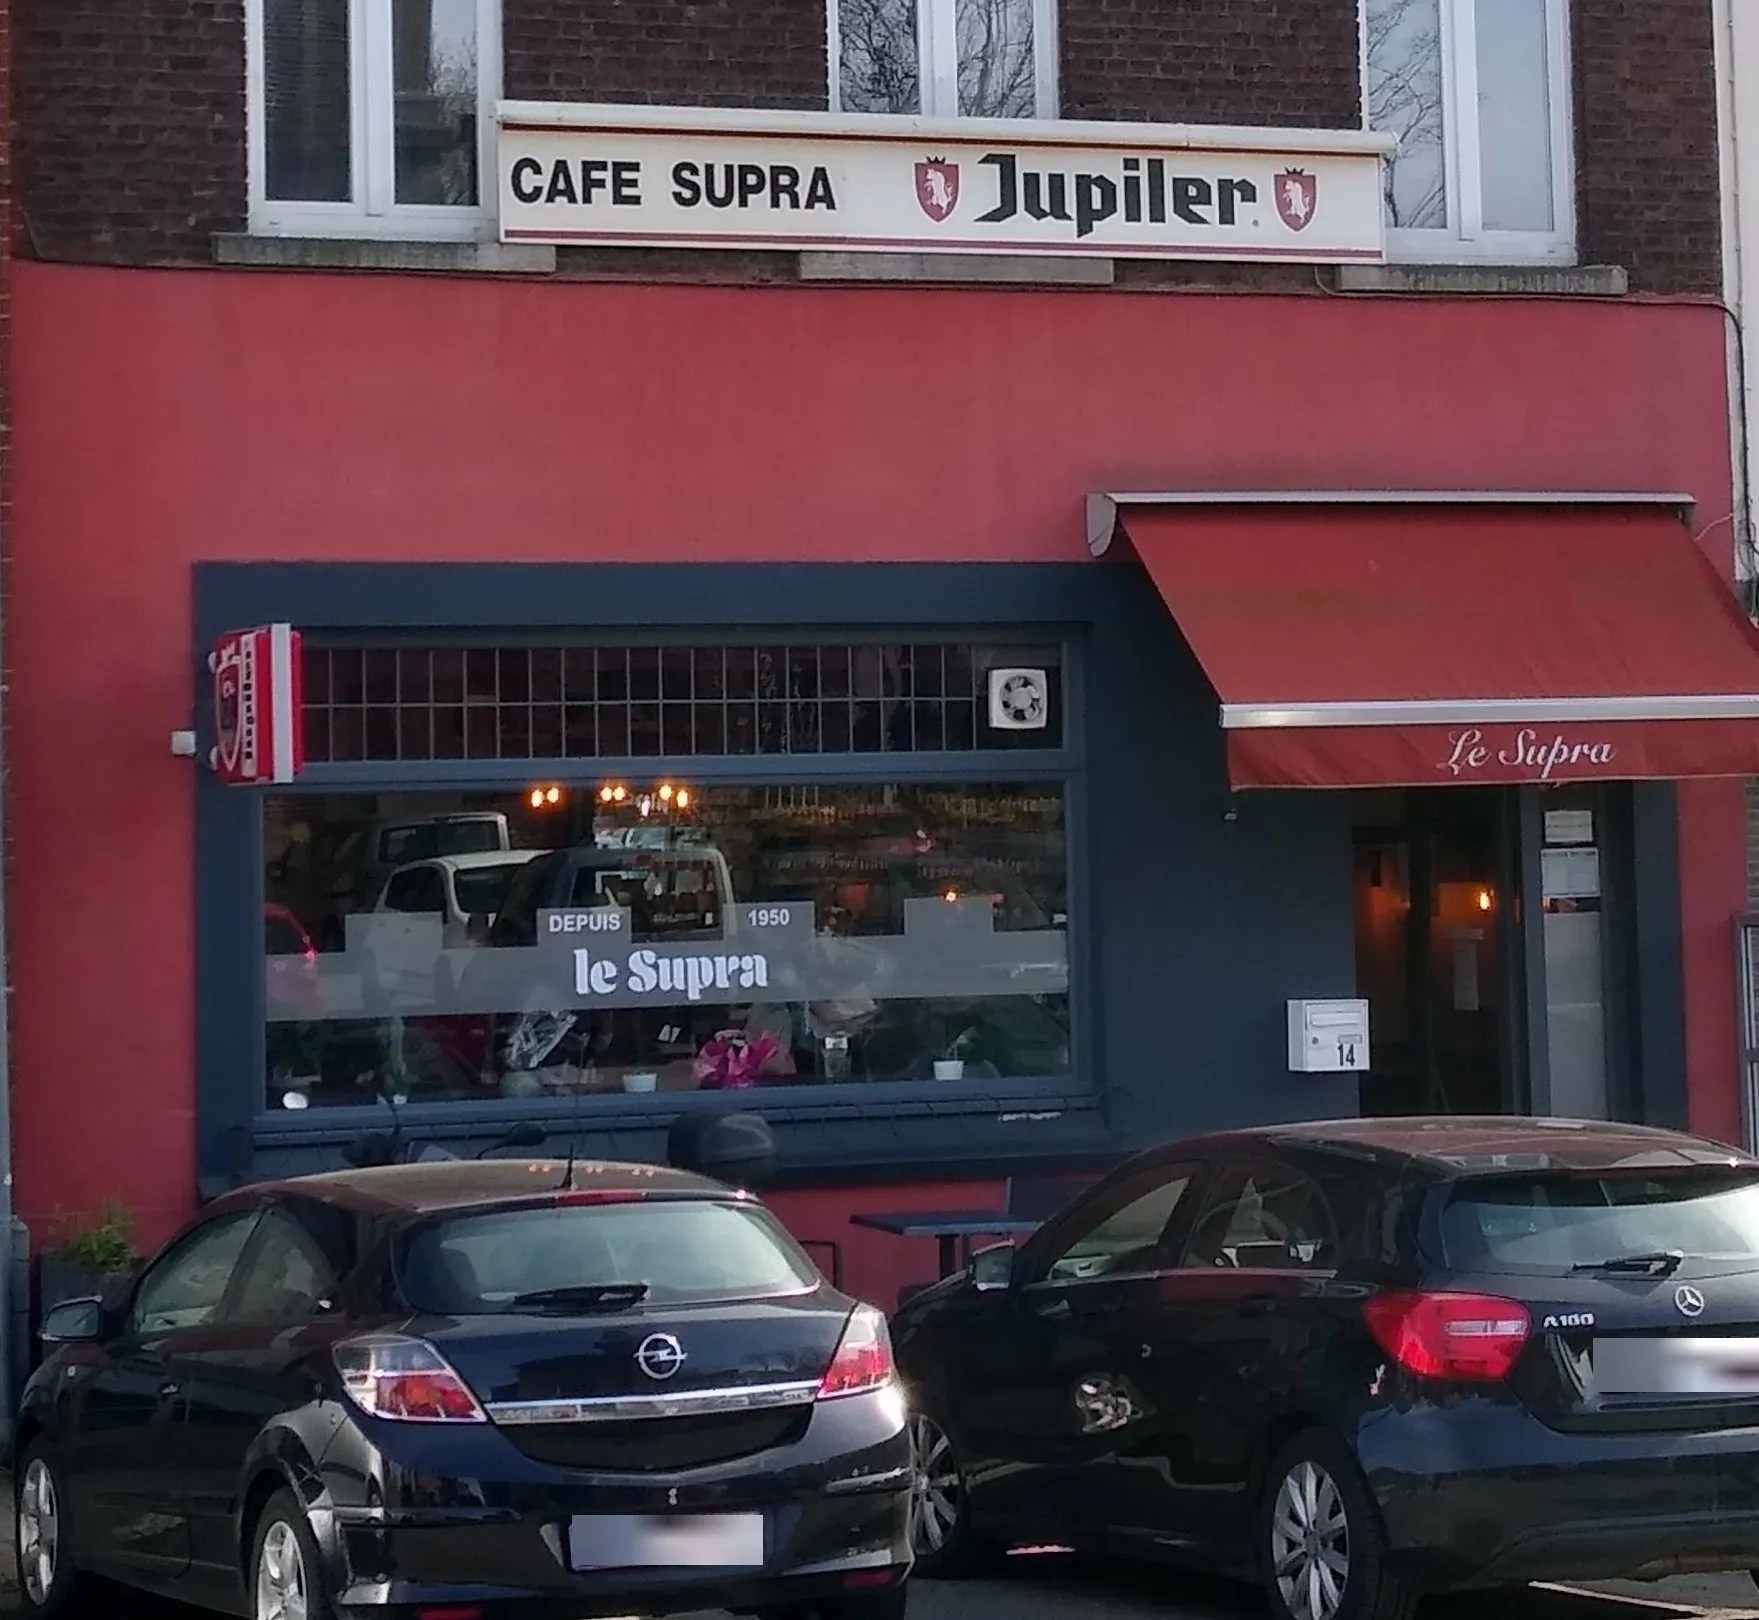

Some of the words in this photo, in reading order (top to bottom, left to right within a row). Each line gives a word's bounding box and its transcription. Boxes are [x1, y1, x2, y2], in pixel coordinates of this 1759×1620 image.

[510, 157, 642, 206] CAFE
[671, 161, 837, 211] SUPRA
[973, 152, 1257, 238] Jupiler
[1436, 728, 1491, 776] Le
[1498, 728, 1615, 779] Supra
[549, 912, 622, 932] DEPUIS
[748, 908, 790, 927] 1950
[573, 948, 618, 995] le
[627, 949, 768, 1001] Supra
[1337, 1043, 1356, 1067] 14
